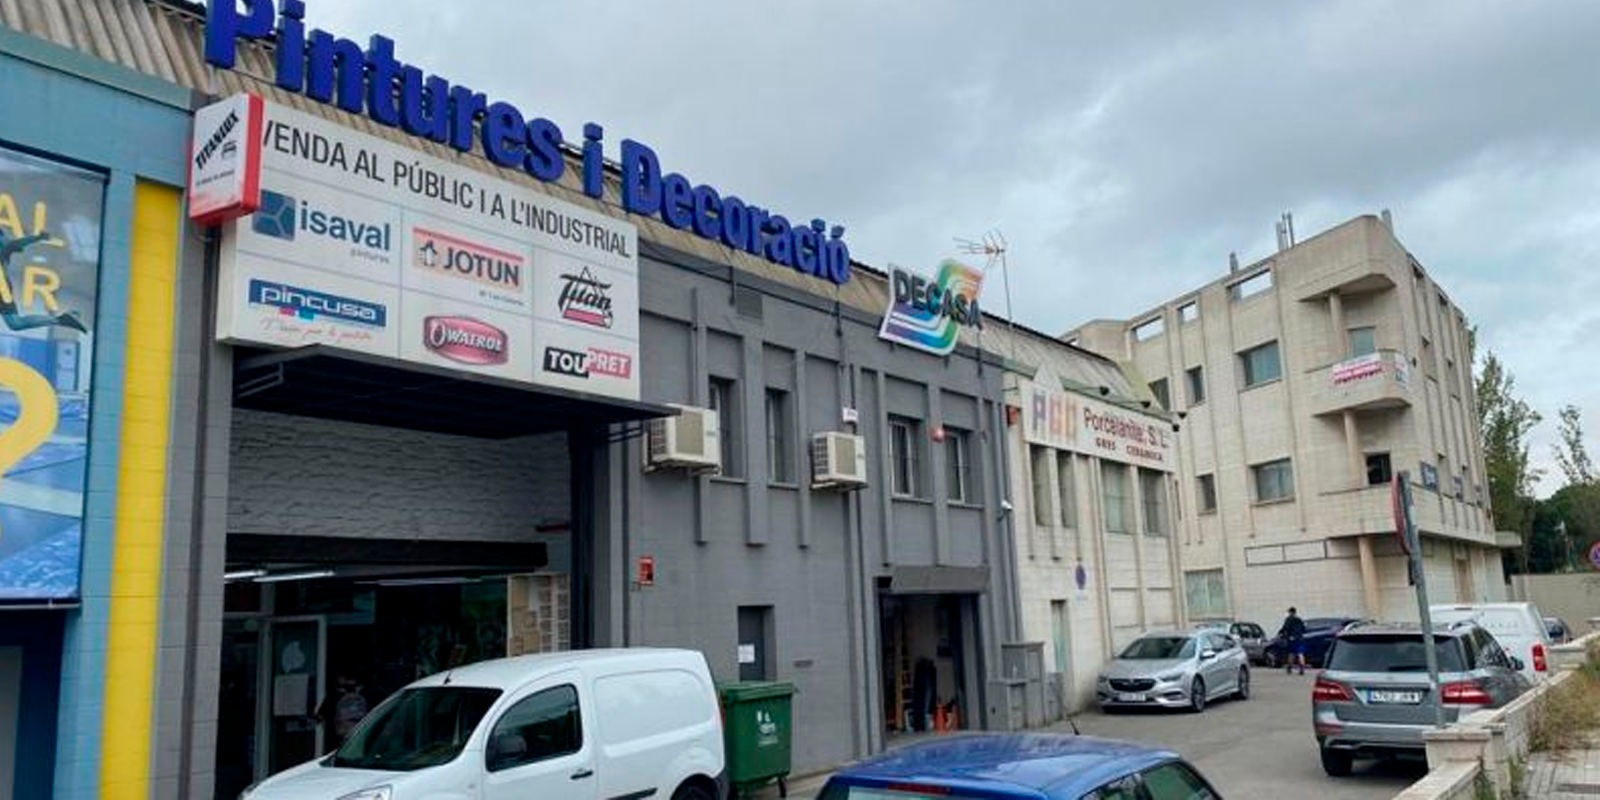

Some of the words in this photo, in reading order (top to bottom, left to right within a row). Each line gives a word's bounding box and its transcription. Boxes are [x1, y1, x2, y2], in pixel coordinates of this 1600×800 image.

[205, 0, 565, 182] Pintures
[582, 122, 604, 199] i
[620, 138, 851, 284] Decoració
[300, 201, 391, 251] isaval
[353, 149, 385, 183] AL
[393, 160, 473, 210] PÚBLIC
[480, 189, 485, 214] I
[490, 194, 506, 220] A
[511, 197, 631, 259] L'INDUSTRIAL
[443, 247, 520, 287] JOTUN
[260, 286, 377, 320] pincusa
[557, 274, 612, 312] Titan
[894, 269, 982, 330] DECASA
